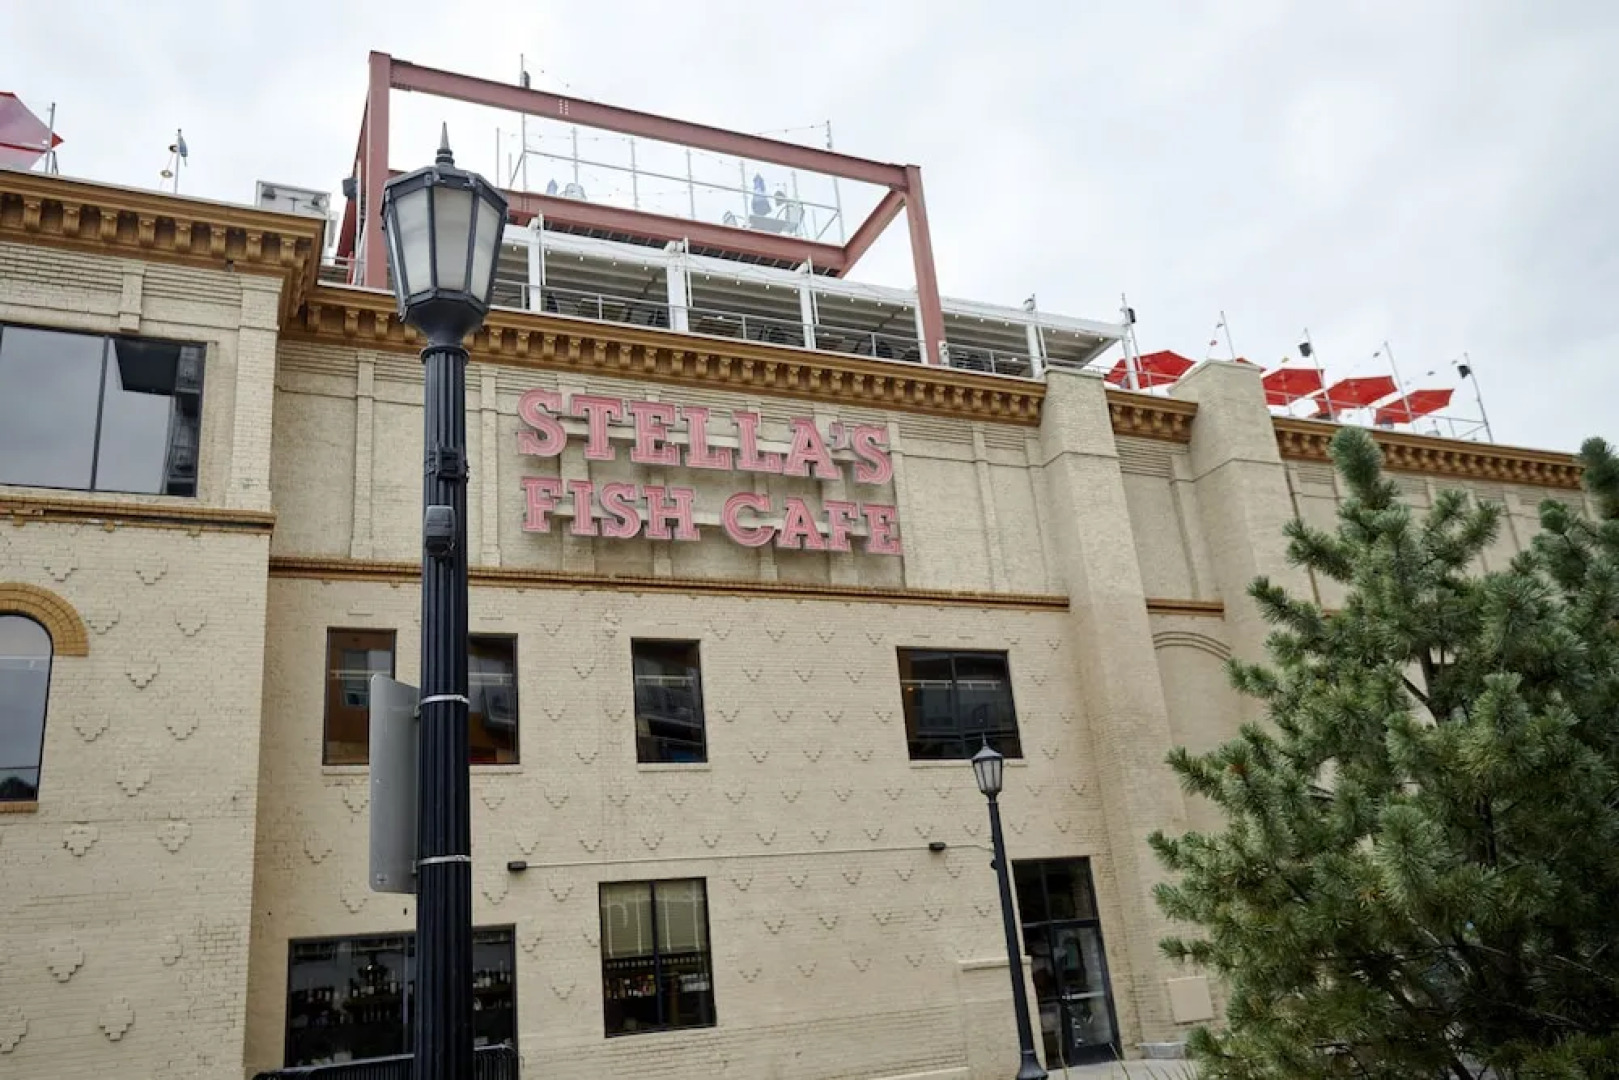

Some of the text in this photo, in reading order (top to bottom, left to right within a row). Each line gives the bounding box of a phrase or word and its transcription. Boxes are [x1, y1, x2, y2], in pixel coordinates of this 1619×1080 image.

[517, 387, 894, 485] STELLA'S
[520, 476, 901, 555] FISH CAFE
